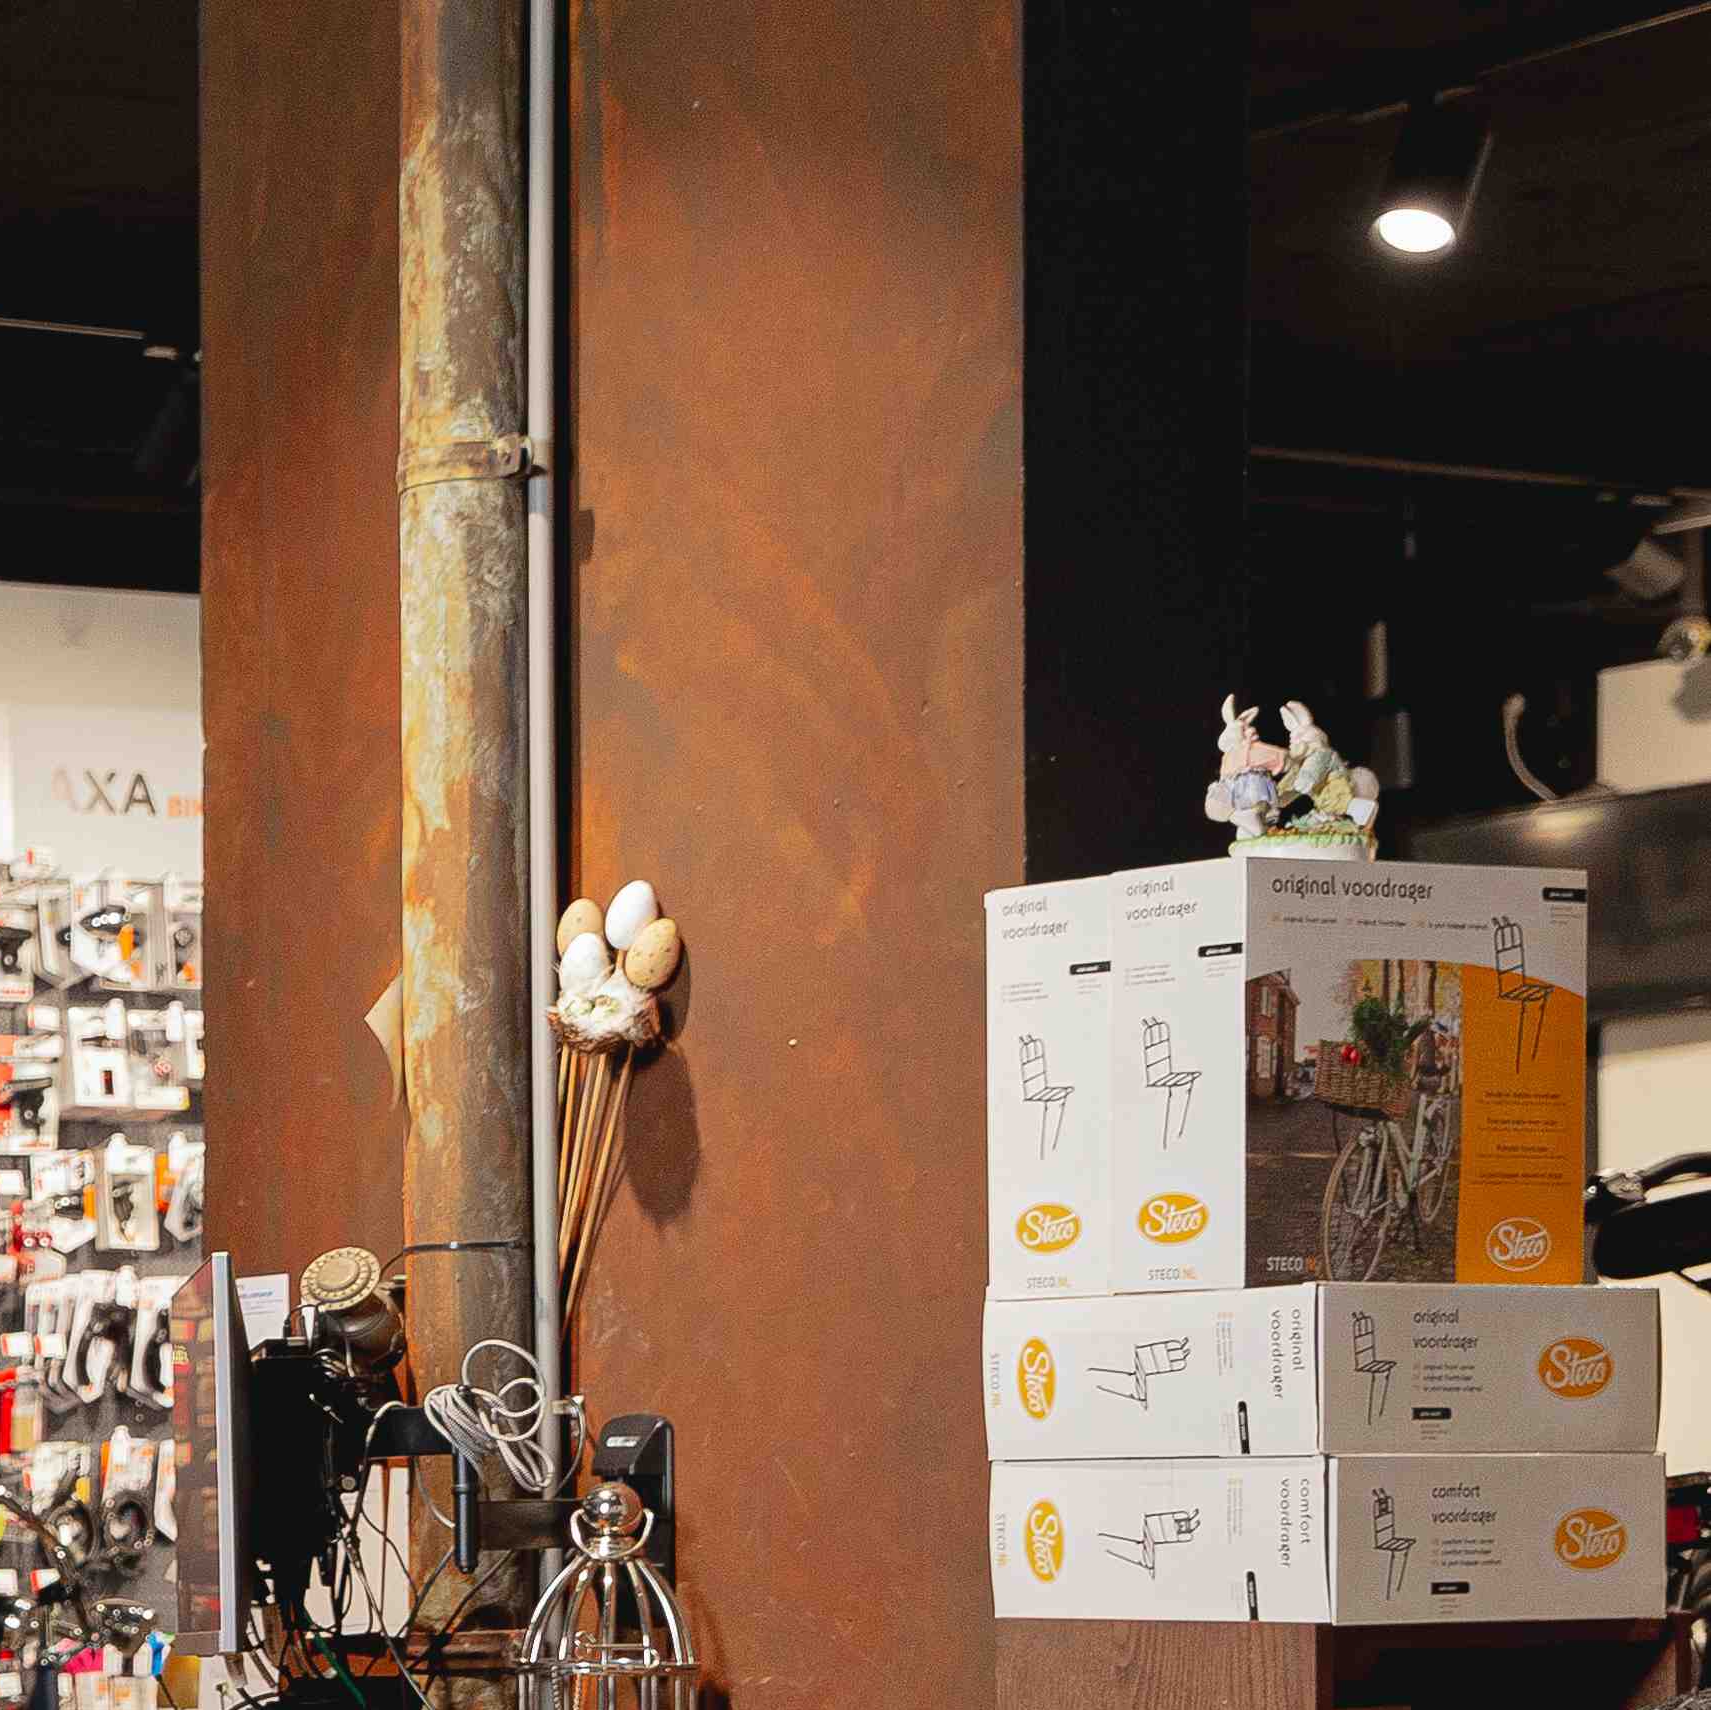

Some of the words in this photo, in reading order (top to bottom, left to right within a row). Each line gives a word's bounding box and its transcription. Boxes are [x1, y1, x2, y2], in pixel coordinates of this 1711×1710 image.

[1125, 876, 1174, 897] original
[1272, 875, 1336, 899] original
[1342, 876, 1433, 905] voordrager
[1002, 896, 1048, 917] original
[1125, 901, 1198, 921] voordrager
[1002, 920, 1069, 940] voordrager
[1022, 1210, 1076, 1246] Steco
[1144, 1200, 1205, 1237] Steco
[1413, 1309, 1460, 1327] original
[1290, 1306, 1306, 1372] original
[1413, 1334, 1478, 1351] voordrager
[1268, 1309, 1284, 1399] voordrager
[1432, 1483, 1481, 1500] comfort
[1278, 1477, 1292, 1568] voordrager
[1431, 1509, 1497, 1526] voordrager
